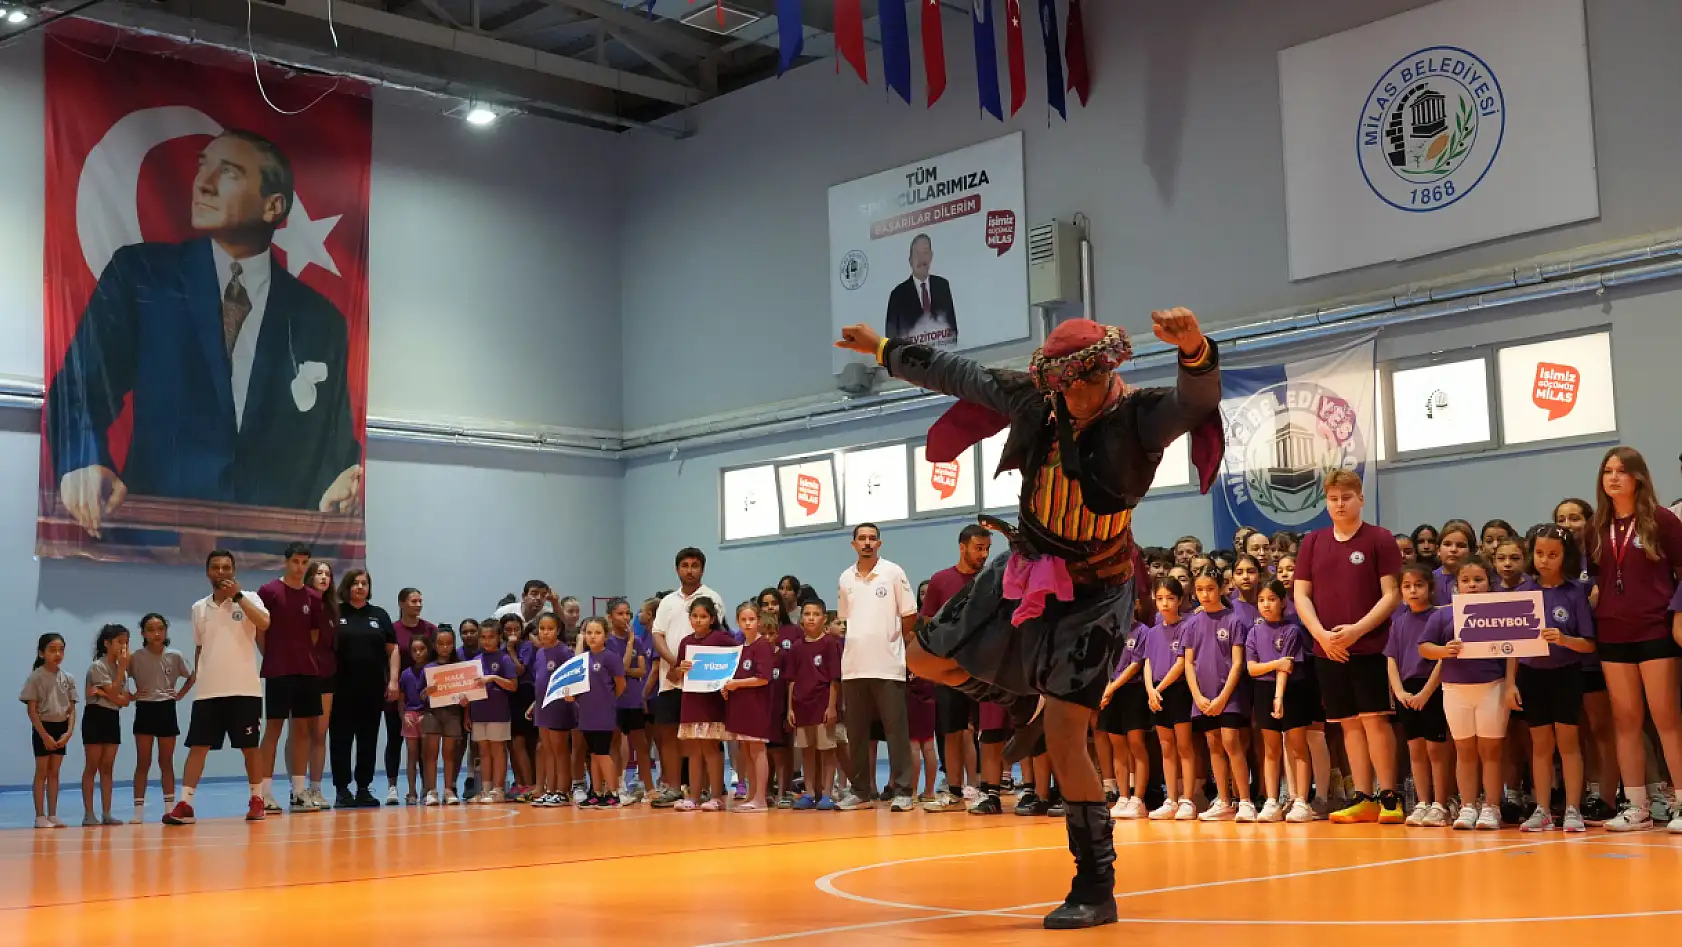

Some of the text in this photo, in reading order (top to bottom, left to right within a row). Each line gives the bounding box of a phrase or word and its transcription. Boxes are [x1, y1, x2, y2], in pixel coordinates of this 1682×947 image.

[1363, 57, 1500, 147] MİLAS BELEDİYESİ
[905, 166, 938, 188] TÜM
[1409, 180, 1456, 205] 1868
[874, 199, 976, 236] BAŞARILAR DİLERİM
[1536, 387, 1573, 403] MİLAS
[1468, 617, 1530, 628] VOLEYBOL
